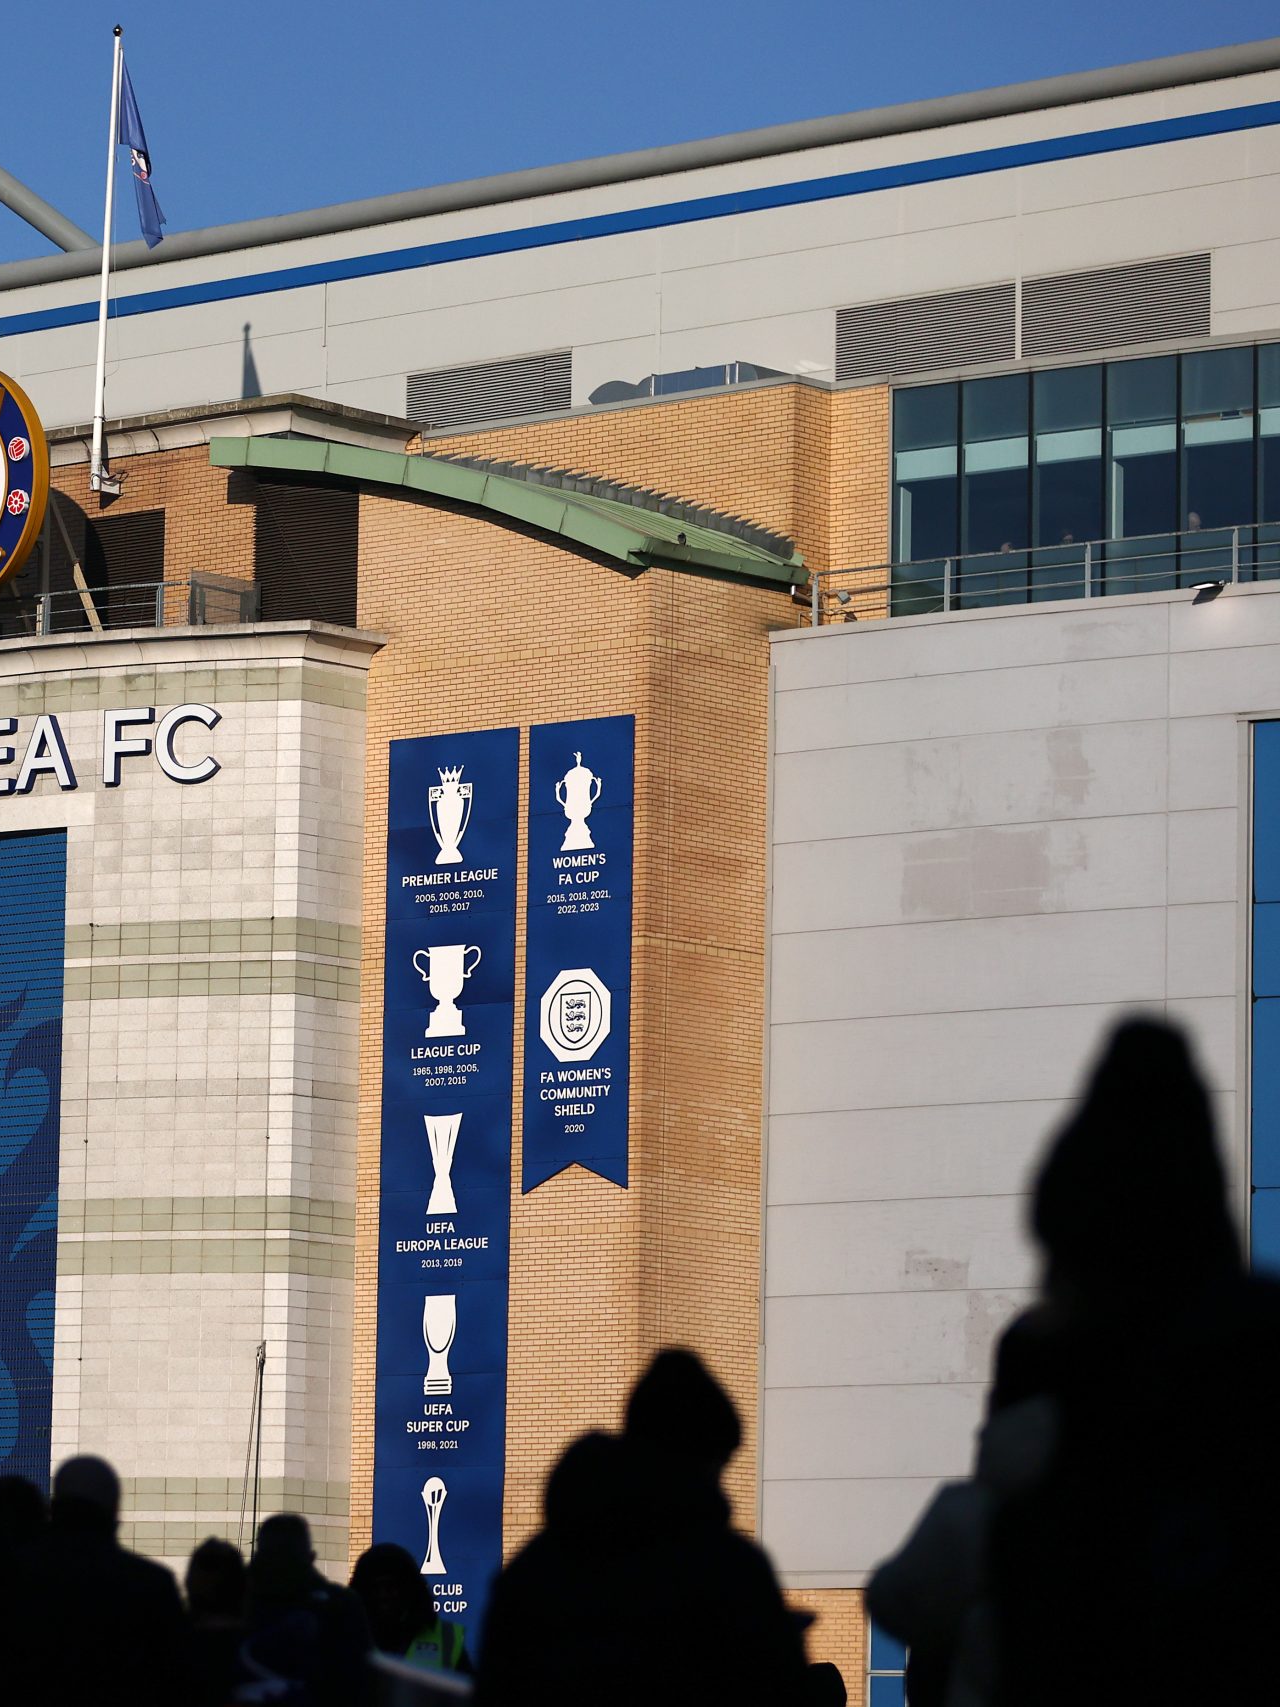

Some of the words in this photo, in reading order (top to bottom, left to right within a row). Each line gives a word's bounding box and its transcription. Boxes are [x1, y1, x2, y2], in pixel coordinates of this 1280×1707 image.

[103, 703, 222, 787] FC
[553, 853, 606, 869] WOMEN'S
[402, 873, 451, 887] PREMIER
[454, 868, 498, 883] LEAGUE
[559, 873, 573, 885] FA
[576, 871, 599, 883] CUP
[415, 893, 437, 903] 2005,
[439, 891, 461, 901] 2006,
[463, 889, 484, 899] 2010,
[547, 894, 567, 903] 2015,
[569, 892, 588, 901] 2018,
[591, 890, 611, 899] 2021,
[430, 904, 450, 913] 2015,
[452, 902, 470, 911] 2017
[558, 905, 578, 914] 2022,
[580, 902, 599, 912] 2023
[411, 1045, 454, 1059] LEAGUE
[457, 1044, 481, 1056] CUP
[413, 1067, 433, 1076] 1965,
[435, 1065, 454, 1074] 1998,
[456, 1064, 479, 1073] 2005,
[541, 1072, 554, 1083] FA
[557, 1067, 611, 1082] WOMEN'S
[425, 1077, 446, 1086] 2007,
[448, 1076, 466, 1085] 2015
[540, 1085, 610, 1100] COMMUNITY
[554, 1103, 595, 1116] SHIELD
[565, 1124, 585, 1133] 2020
[426, 1222, 455, 1234] UEFA
[396, 1239, 441, 1252] EUROPA
[444, 1237, 488, 1250] LEAGUE
[422, 1259, 442, 1268] 2013,
[444, 1258, 462, 1267] 2019
[424, 1404, 453, 1415] UEFA
[407, 1421, 443, 1433] SUPER
[446, 1420, 469, 1432] CUP
[418, 1441, 438, 1450] 1998,
[440, 1440, 458, 1449] 2021
[433, 1584, 463, 1596] CLUB
[443, 1601, 467, 1613] CUP
